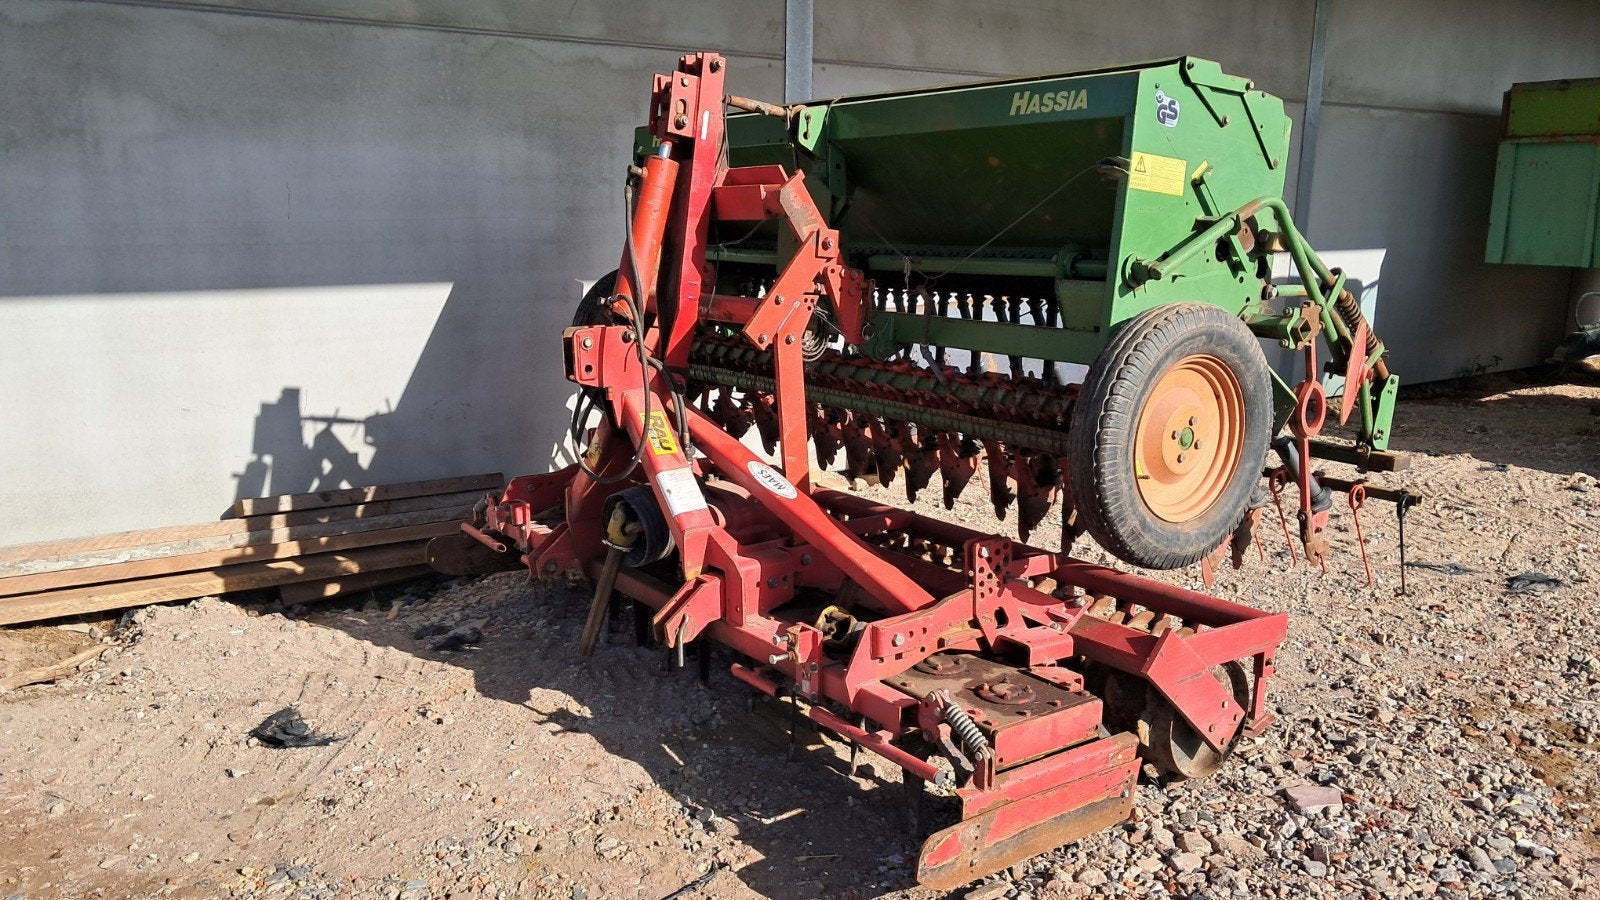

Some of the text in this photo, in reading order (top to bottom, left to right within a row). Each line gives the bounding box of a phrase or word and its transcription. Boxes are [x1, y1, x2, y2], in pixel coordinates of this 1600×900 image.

[1009, 89, 1088, 116] HASSIA
[1156, 100, 1178, 124] GS
[650, 415, 673, 451] RAU
[757, 470, 786, 490] MAES
